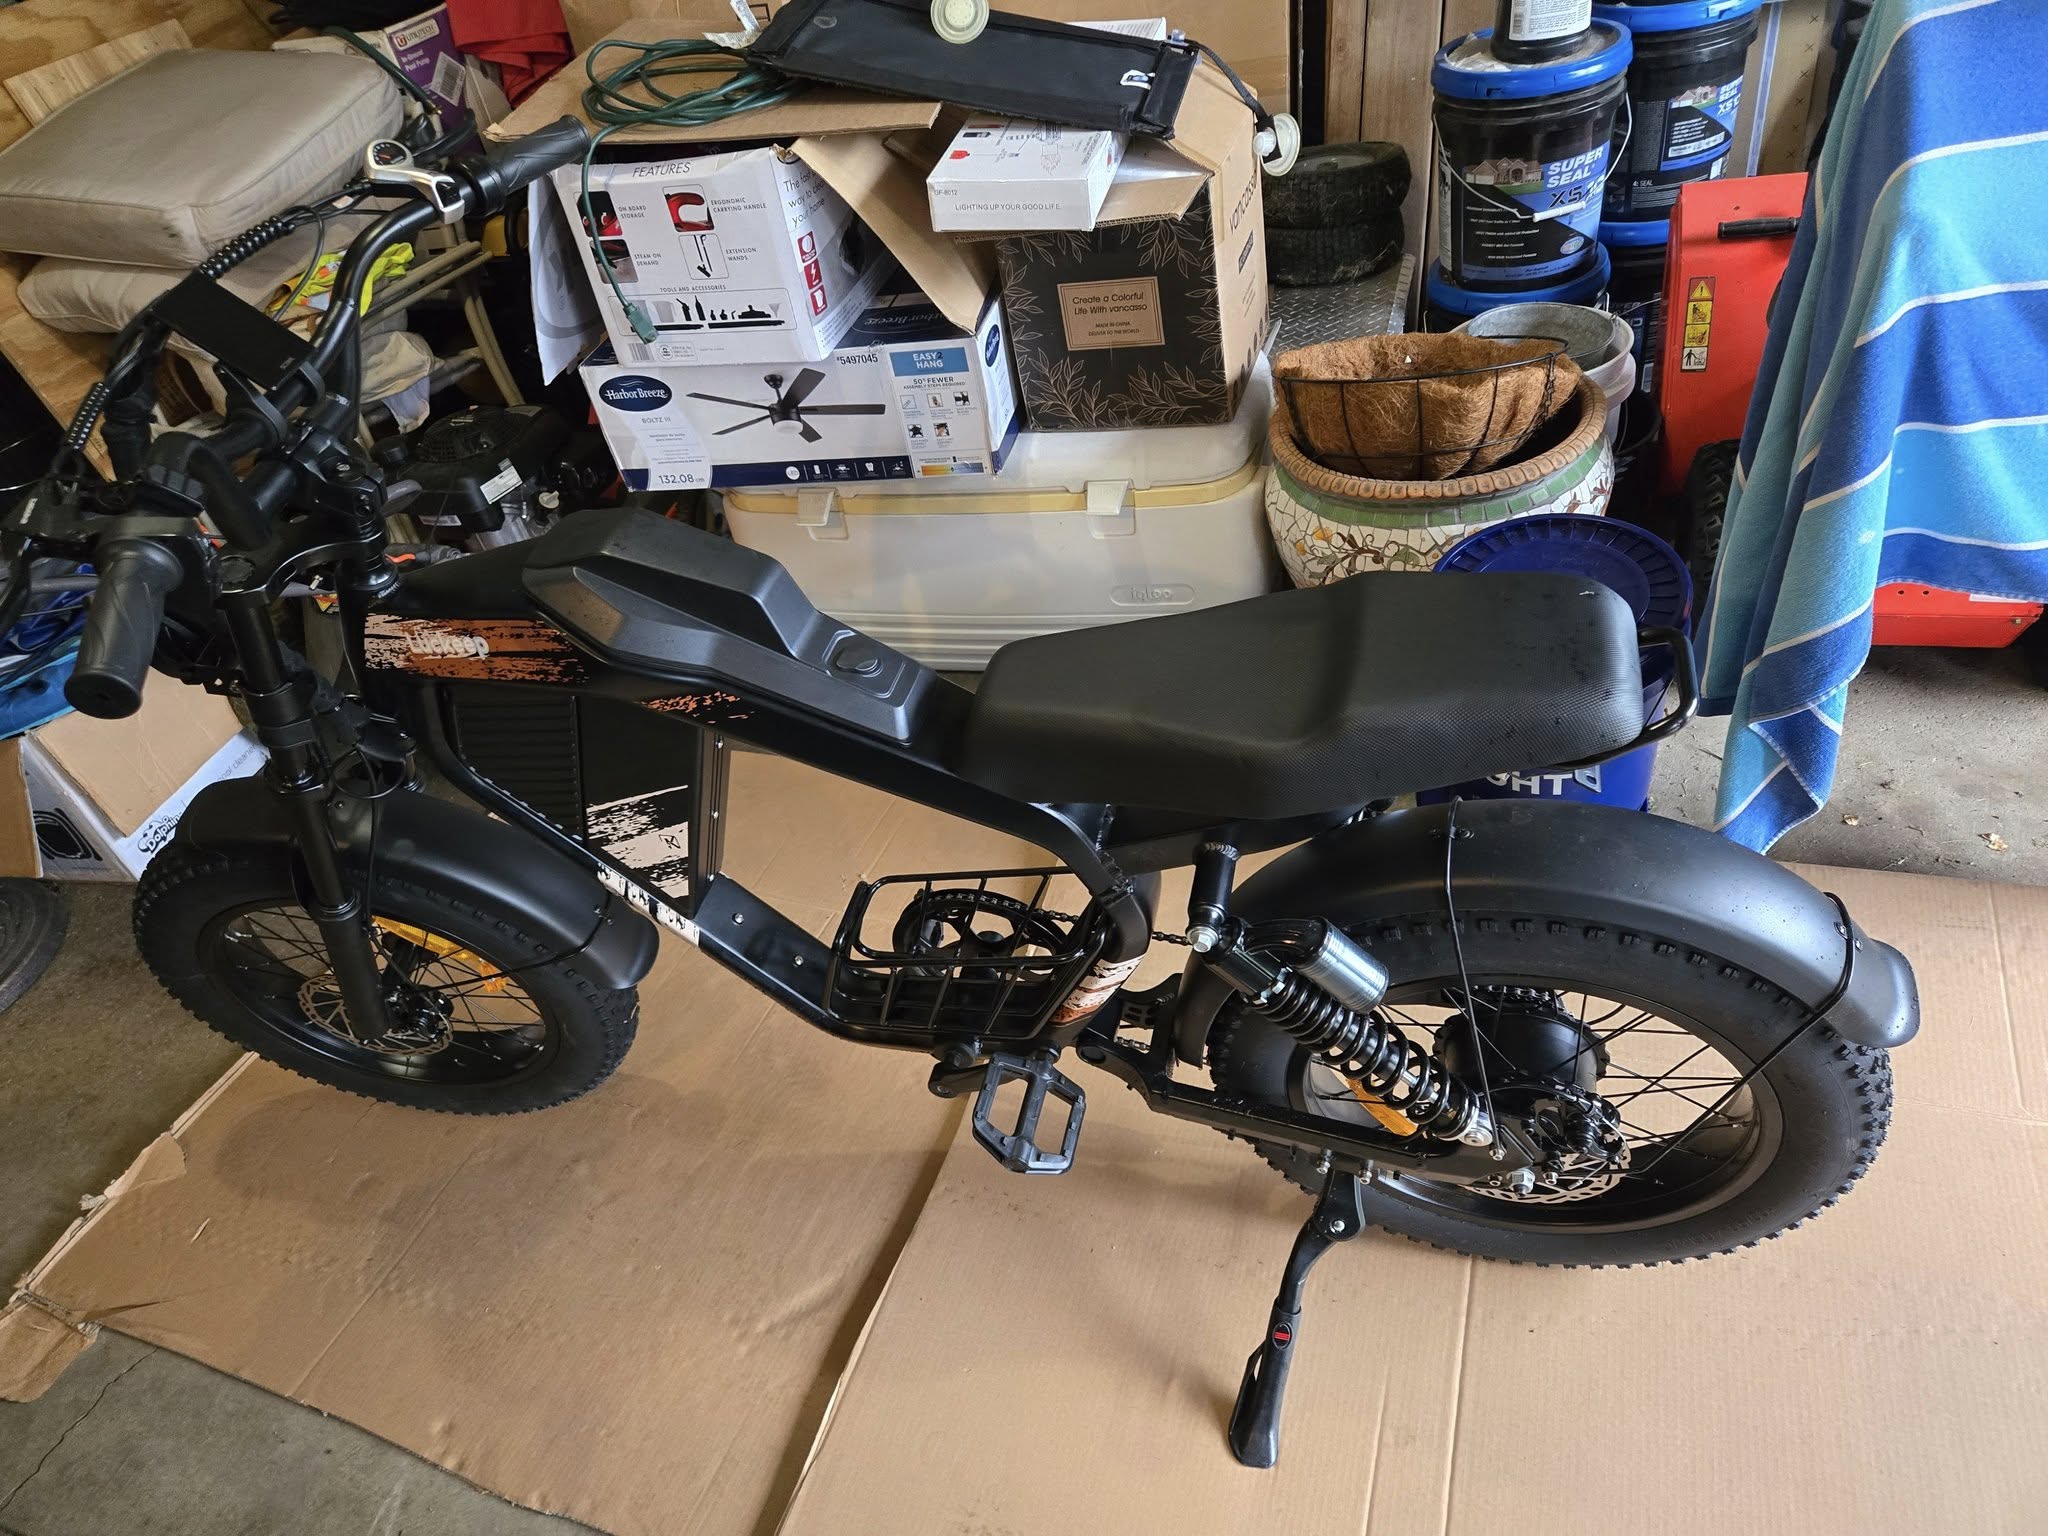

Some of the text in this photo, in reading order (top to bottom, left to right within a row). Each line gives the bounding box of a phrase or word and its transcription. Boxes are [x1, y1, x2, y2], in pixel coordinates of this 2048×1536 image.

[1548, 146, 1604, 175] SUPER
[632, 162, 691, 178] FEATURES
[783, 179, 800, 192] The
[788, 196, 805, 208] way
[813, 180, 825, 194] clea
[711, 197, 746, 206] ERGONOMIC
[713, 205, 743, 213] CARRYING
[792, 210, 808, 228] your
[1073, 296, 1101, 305] Create
[1111, 292, 1144, 302] Colorful
[1074, 303, 1148, 315] Life With vancasso
[916, 360, 944, 369] HANG
[927, 376, 954, 384] FEWER
[604, 387, 668, 400] Harbor Breeze
[658, 473, 695, 485] 132.08
[1131, 586, 1173, 601] igloo
[405, 631, 490, 660] Luckeep
[232, 743, 257, 769] cleaner
[145, 815, 181, 853] Dolphin
